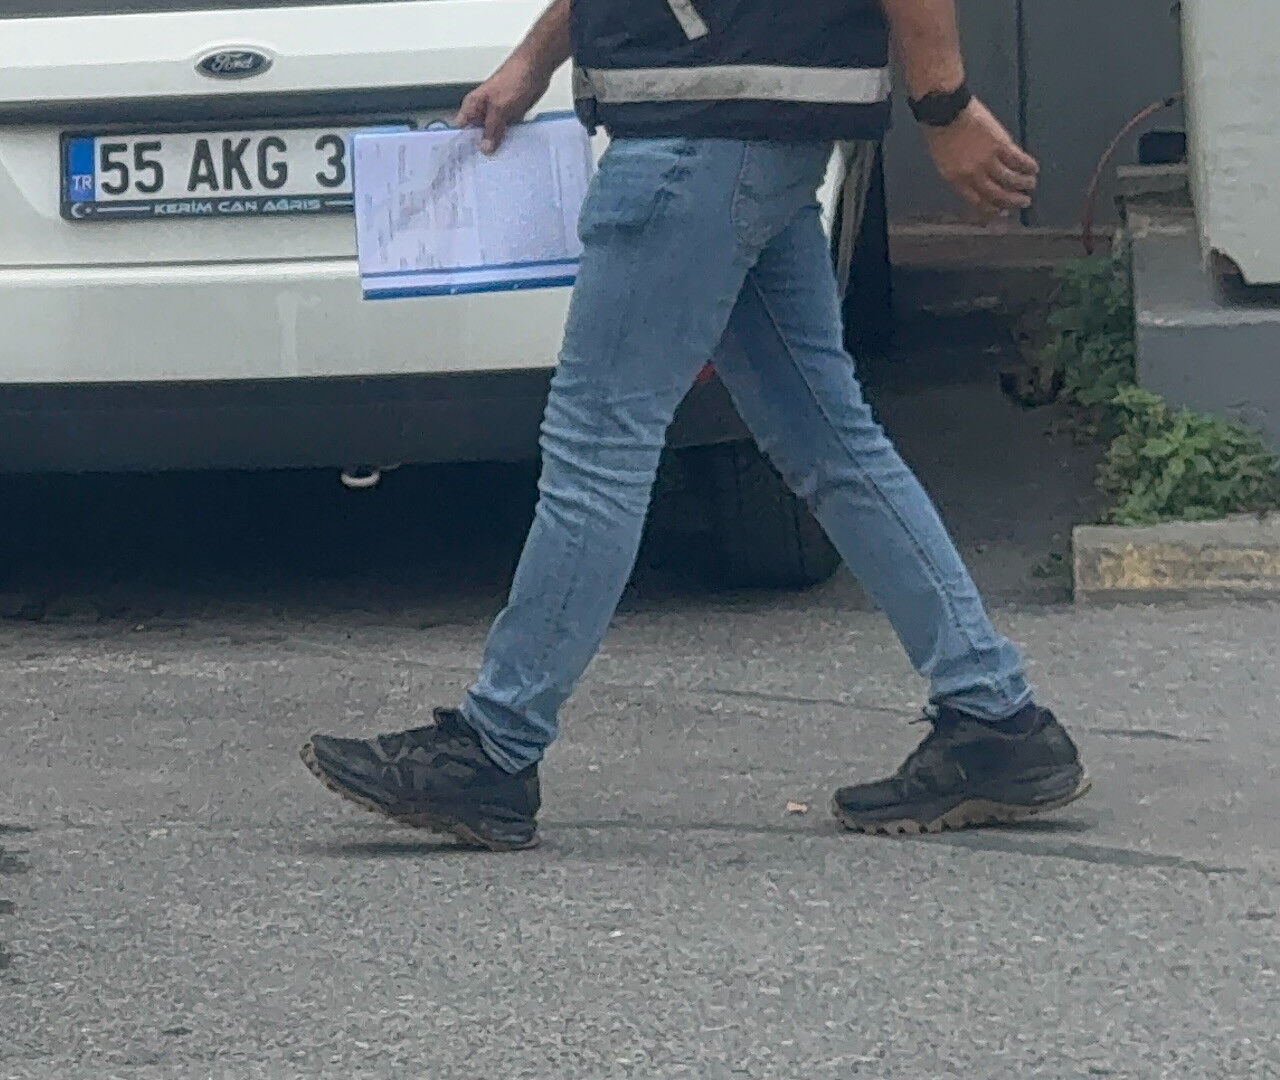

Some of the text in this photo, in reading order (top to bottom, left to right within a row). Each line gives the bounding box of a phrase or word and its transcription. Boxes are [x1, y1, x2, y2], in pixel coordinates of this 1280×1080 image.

[100, 133, 347, 195] 55 AKG 3
[72, 174, 91, 191] TR
[154, 200, 213, 215] KERİM
[217, 200, 259, 213] CAN
